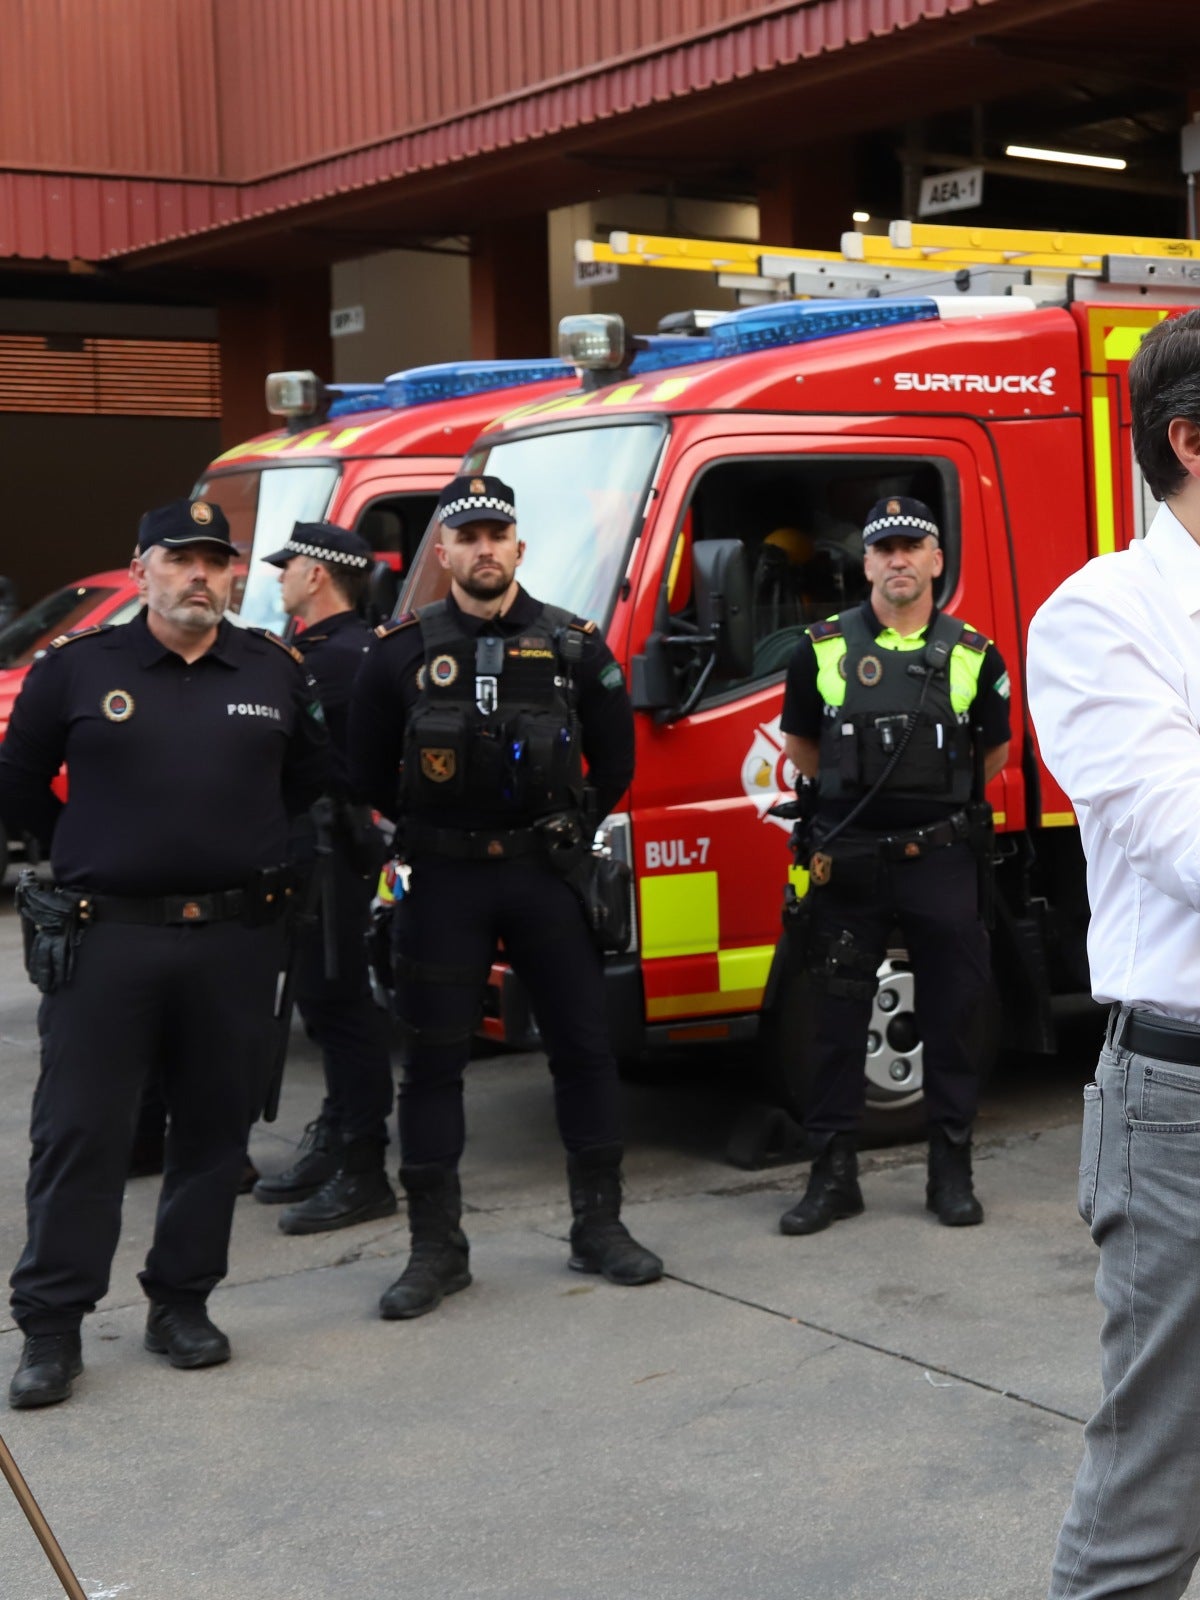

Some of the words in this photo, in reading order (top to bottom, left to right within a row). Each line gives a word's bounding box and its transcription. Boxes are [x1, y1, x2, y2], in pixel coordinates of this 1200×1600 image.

[928, 175, 977, 206] AEA-1
[893, 372, 1040, 394] SURTRUCK
[227, 703, 280, 721] POLICIA
[645, 837, 710, 869] BUL-7
